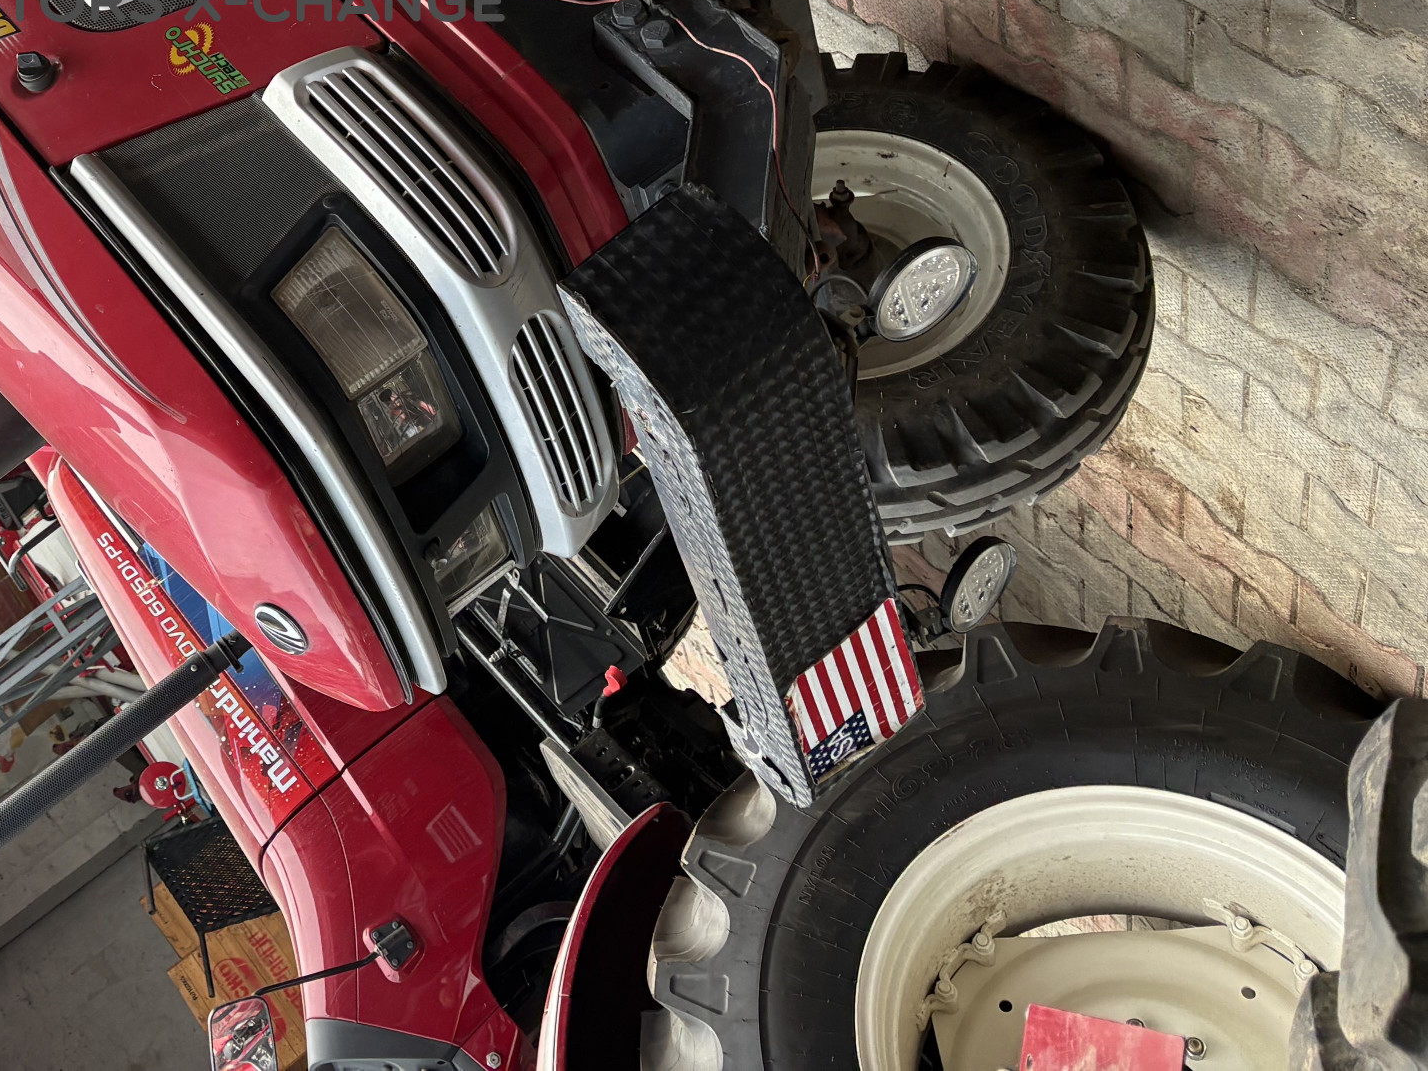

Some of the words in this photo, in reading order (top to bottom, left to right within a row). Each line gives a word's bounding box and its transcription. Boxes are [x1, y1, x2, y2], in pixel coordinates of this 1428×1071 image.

[160, 614, 200, 658] OVO
[207, 673, 298, 793] Mahindr
[797, 844, 836, 905] NYLON
